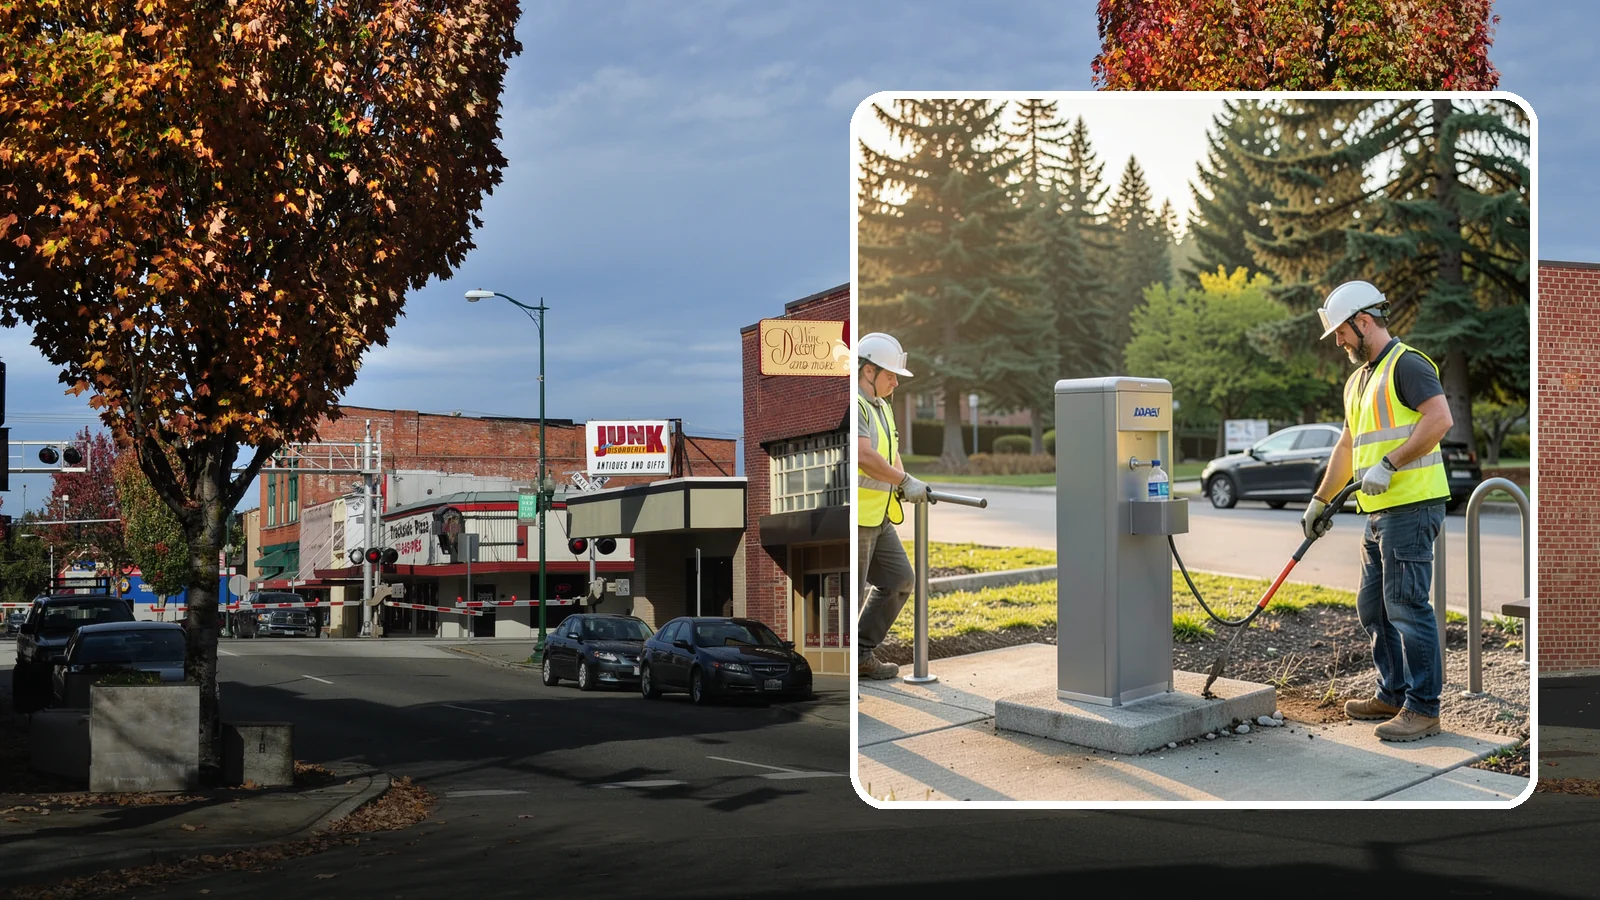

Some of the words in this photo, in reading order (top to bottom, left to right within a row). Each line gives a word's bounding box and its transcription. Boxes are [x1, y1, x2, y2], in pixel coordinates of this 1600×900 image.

[596, 425, 665, 457] JUNK
[607, 446, 645, 454] DISORDERLY
[597, 461, 628, 470] ANTIQUES
[631, 461, 644, 470] AND
[647, 460, 666, 470] GIFTS
[414, 520, 429, 535] Pizza
